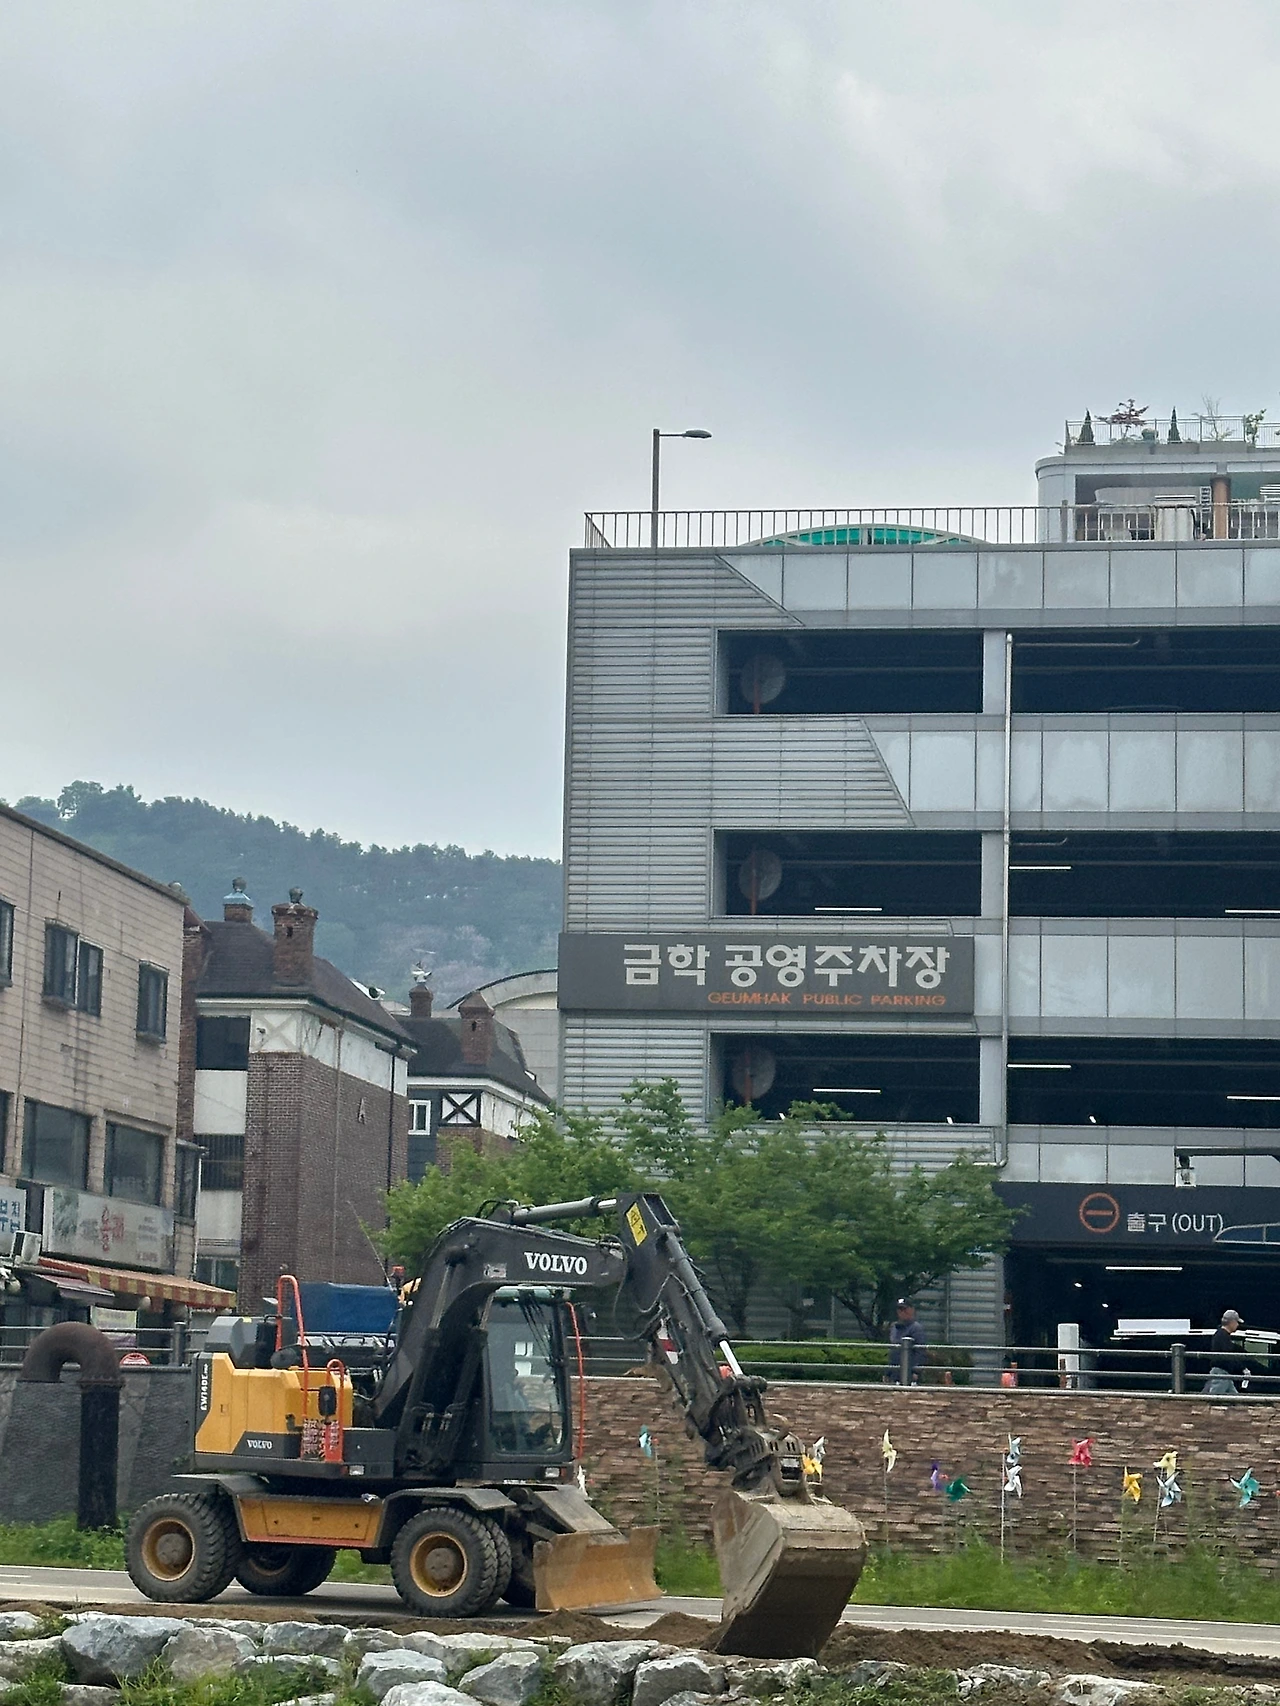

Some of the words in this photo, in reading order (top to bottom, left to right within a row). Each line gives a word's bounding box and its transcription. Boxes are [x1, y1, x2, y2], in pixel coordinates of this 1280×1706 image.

[623, 943, 711, 986] 금학
[725, 944, 951, 989] 공영주차장
[707, 991, 792, 1005] GEUMHAK
[802, 993, 863, 1006] PUBLIC
[870, 994, 947, 1007] PARKING
[523, 1251, 588, 1276] VOLVO
[246, 1439, 274, 1450] VOLVO
